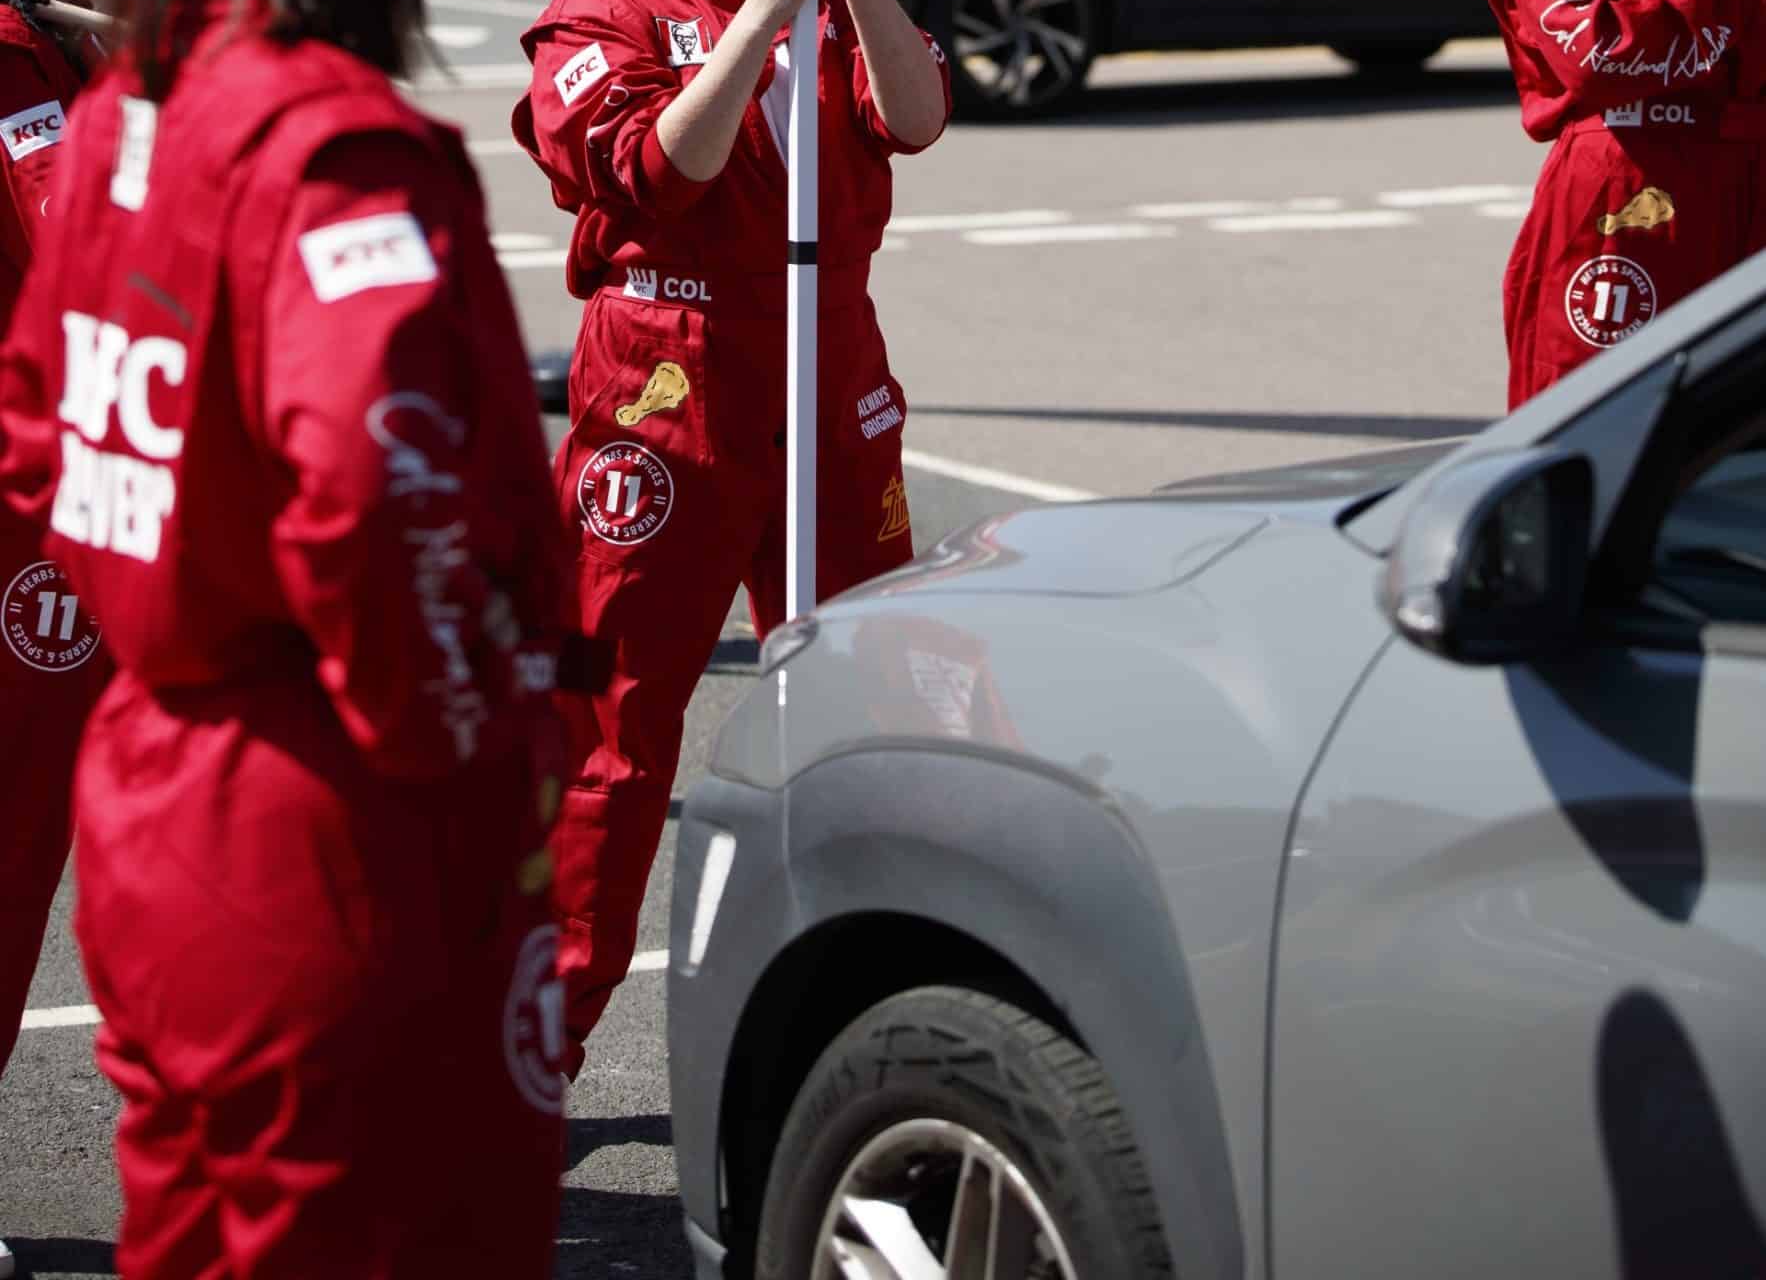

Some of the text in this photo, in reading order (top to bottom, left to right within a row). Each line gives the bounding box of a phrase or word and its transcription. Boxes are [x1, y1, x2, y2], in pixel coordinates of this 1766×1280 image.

[563, 56, 599, 93] KFC
[13, 114, 61, 146] KFC
[1650, 103, 1697, 124] COL
[663, 276, 712, 302] COL
[1593, 281, 1630, 324] 11
[857, 385, 891, 418] ALWAYS
[861, 404, 903, 440] ORIGINAL
[592, 449, 622, 473] HERBS
[633, 454, 665, 487] SPICES
[605, 470, 641, 518] 11
[623, 512, 657, 537] HERBS
[18, 568, 57, 595] HERBS
[37, 591, 79, 640] 11
[10, 623, 94, 663] HERBS & SPICES
